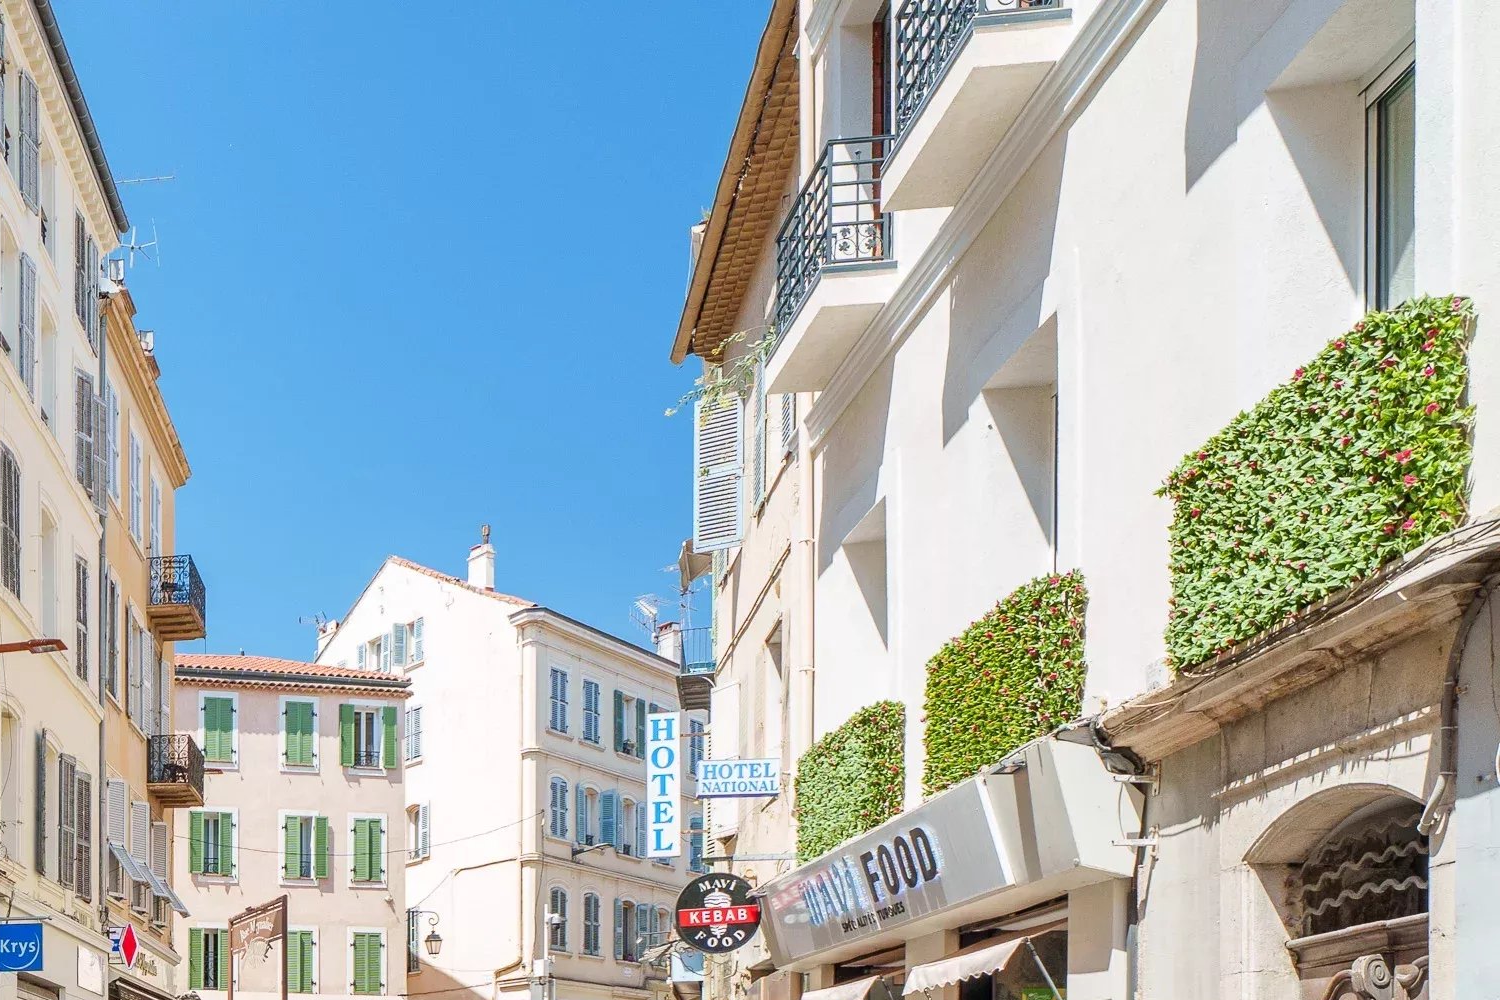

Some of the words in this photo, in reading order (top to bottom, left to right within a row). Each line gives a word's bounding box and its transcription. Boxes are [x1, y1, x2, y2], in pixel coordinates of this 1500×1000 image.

[703, 762, 777, 780] HOTEL
[650, 718, 675, 851] HOTEL
[702, 780, 779, 793] NATIONAL
[860, 827, 937, 903] FOOD
[689, 908, 748, 924] KEBAB
[695, 929, 746, 947] FOOD
[0, 938, 37, 957] Krys
